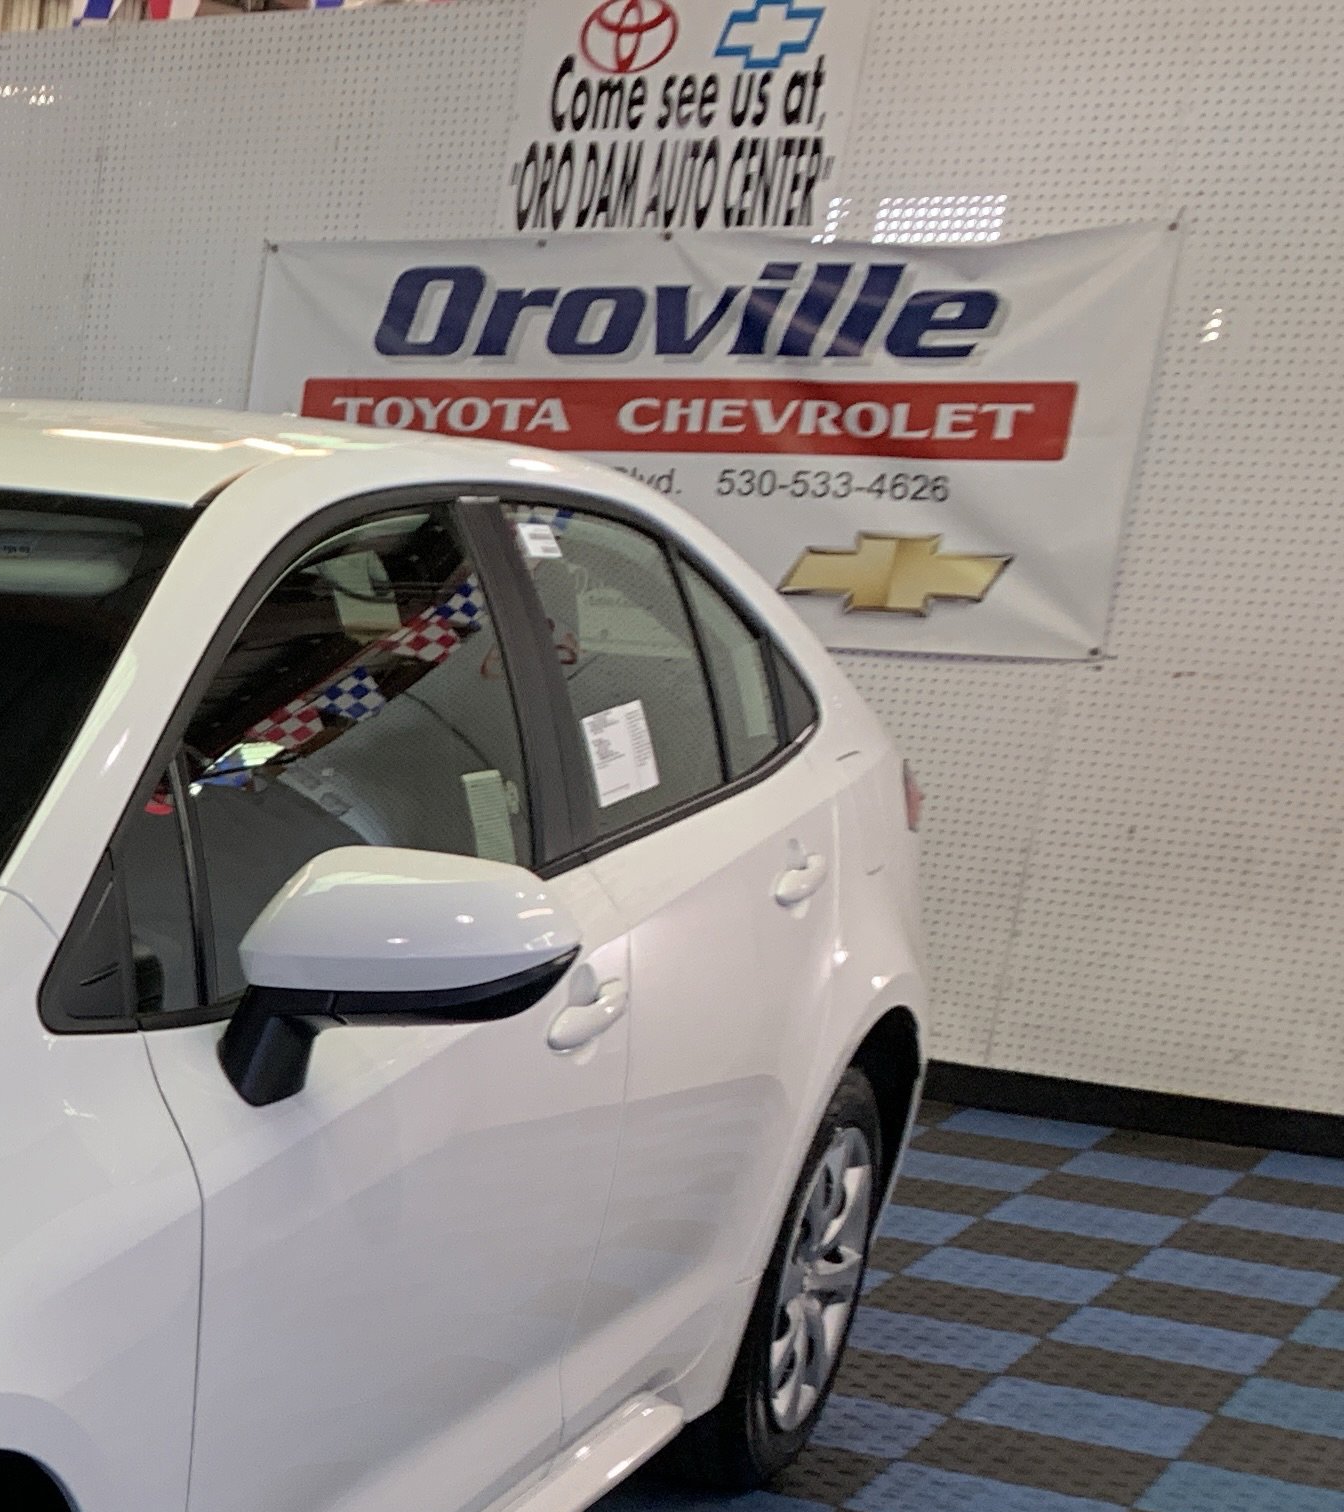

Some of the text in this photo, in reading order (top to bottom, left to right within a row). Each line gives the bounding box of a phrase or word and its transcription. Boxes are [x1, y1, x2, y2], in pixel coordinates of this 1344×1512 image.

[551, 53, 826, 131] Come see us at,
[511, 136, 836, 231] "ORO DAM AUTO CENTER"
[374, 261, 1003, 358] Oroville
[332, 396, 1034, 441] TOYOTA CHEVROLET
[716, 468, 950, 502] 530-533-4626
